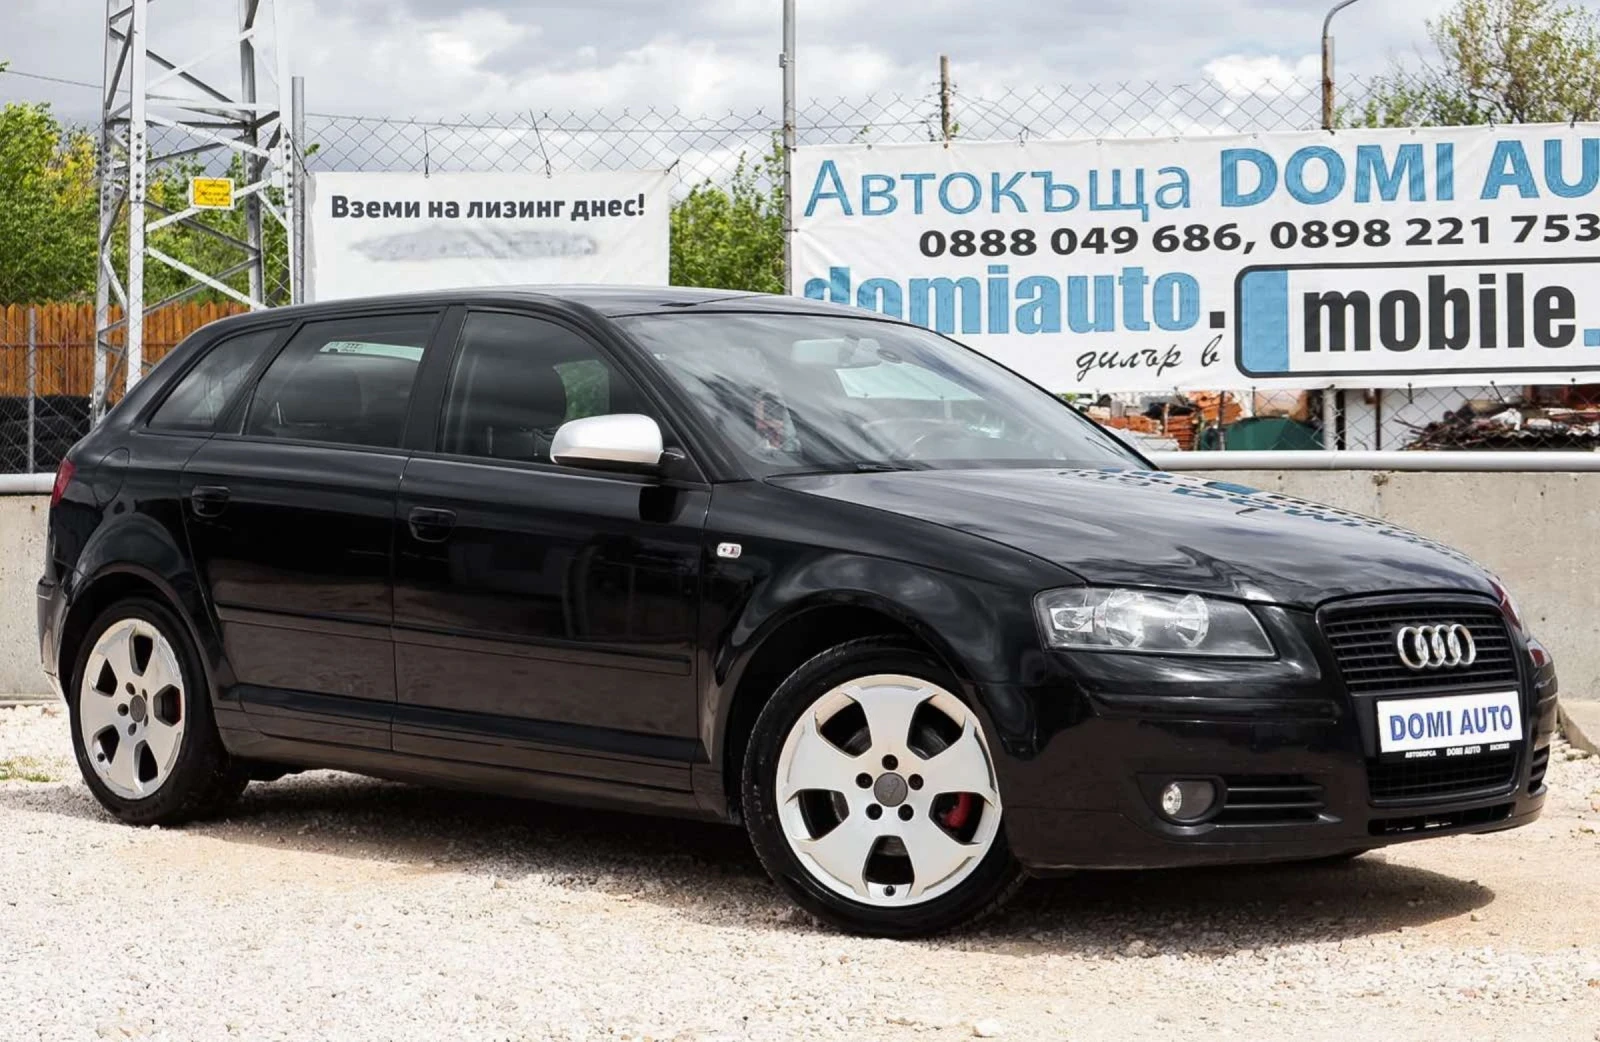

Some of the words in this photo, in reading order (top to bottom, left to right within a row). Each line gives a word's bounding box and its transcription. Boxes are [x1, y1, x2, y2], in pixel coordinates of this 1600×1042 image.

[804, 158, 1192, 222] Автокъща
[1220, 141, 1455, 208] DOMI
[1480, 137, 1600, 200] AU
[331, 195, 420, 218] Вземи
[428, 199, 460, 218] на
[466, 198, 565, 219] лизинг
[570, 194, 646, 221] днес!
[919, 228, 1038, 257] 0888
[1050, 226, 1139, 255] 049
[1152, 222, 1256, 254] 686,
[1270, 219, 1391, 249] 0898
[1405, 215, 1490, 246] 221
[1511, 213, 1600, 243] 753
[1076, 343, 1183, 382] дилър
[1389, 710, 1453, 741] DOMI
[1460, 704, 1513, 735] AUTO
